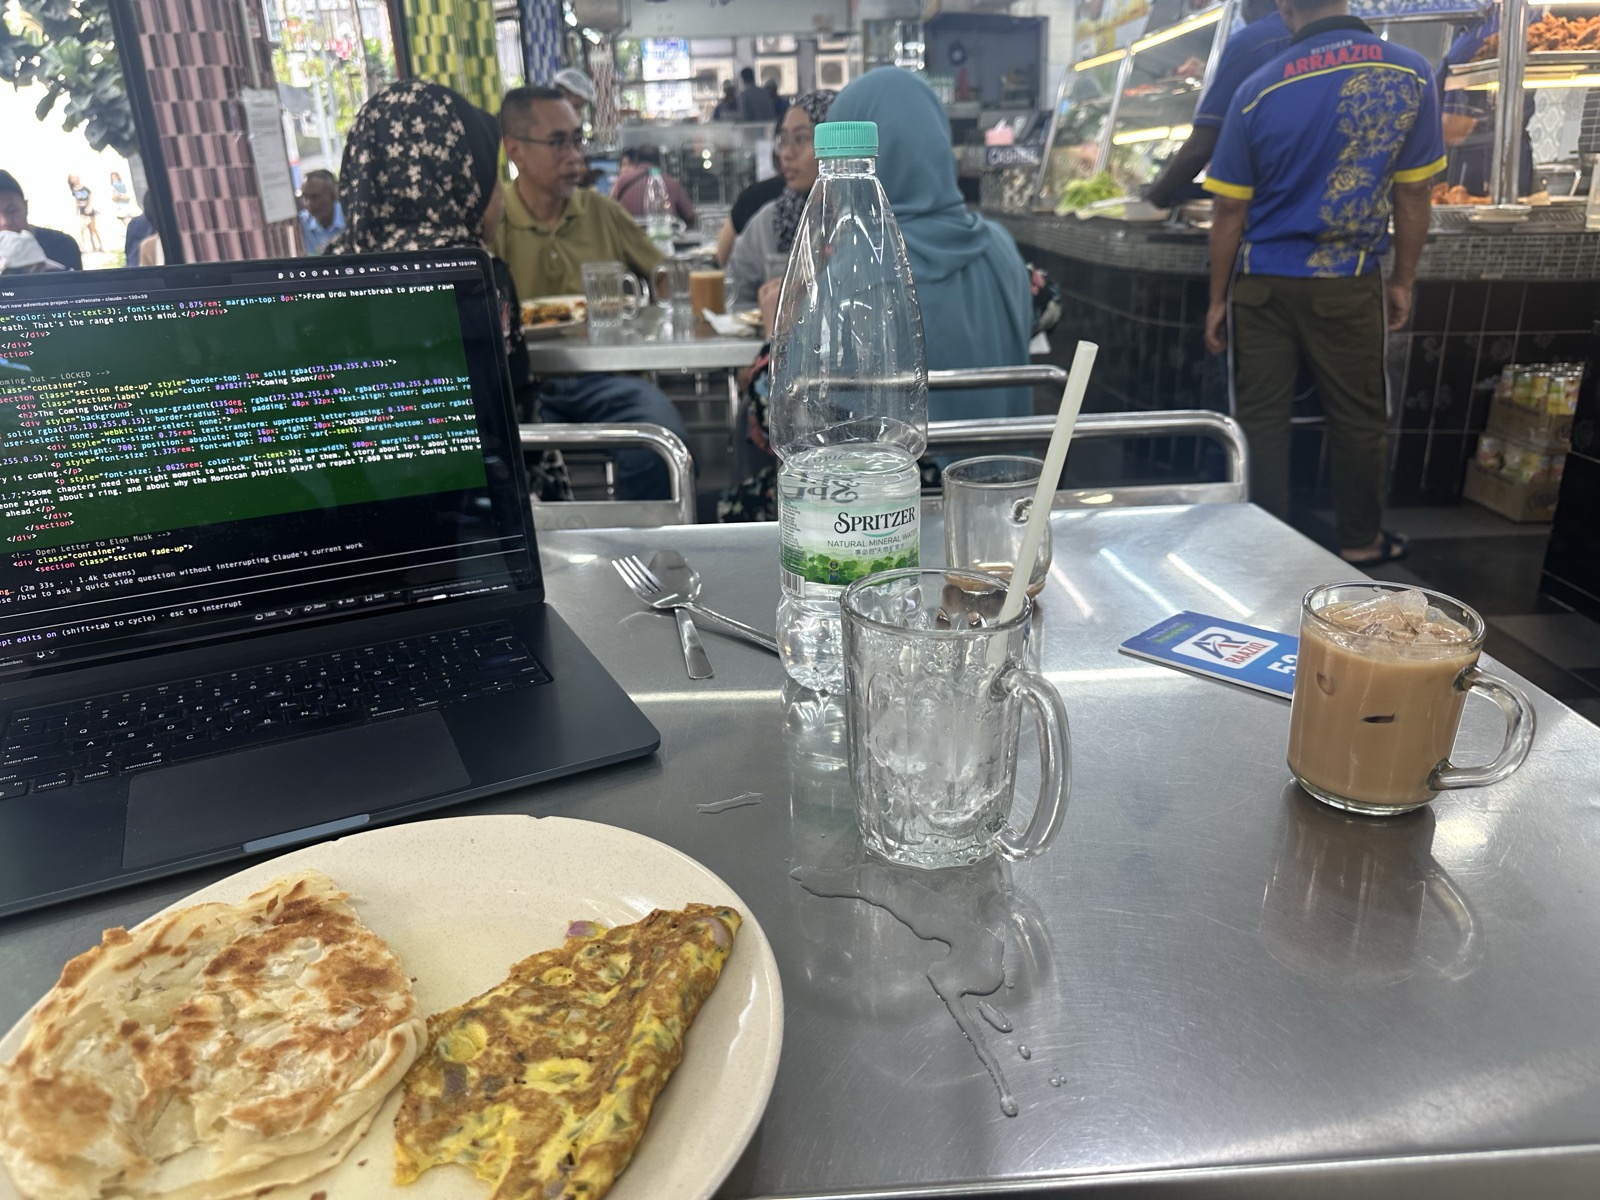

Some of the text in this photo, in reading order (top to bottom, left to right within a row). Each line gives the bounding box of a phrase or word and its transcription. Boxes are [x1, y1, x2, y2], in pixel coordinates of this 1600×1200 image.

[1283, 44, 1383, 78] ARRAAZIQ
[350, 288, 394, 297] heartbreak
[32, 320, 65, 328] That's
[60, 370, 92, 379] LOCKED
[264, 370, 287, 378] solid
[58, 406, 90, 414] Coming
[7, 428, 34, 437] solid
[57, 483, 98, 493] chapters
[101, 479, 122, 487] need
[144, 473, 169, 482] right
[172, 469, 202, 478] moment
[379, 445, 400, 454] about
[427, 440, 448, 448] about
[451, 437, 480, 445] finding
[59, 492, 85, 501] about
[146, 481, 171, 490] about
[211, 473, 248, 482] Moroccan
[252, 467, 288, 478] playlist
[291, 465, 314, 473] plays
[330, 458, 356, 468] repeat
[834, 506, 916, 534] SPRITZER
[36, 547, 57, 555] Open
[61, 542, 92, 551] Letter
[133, 533, 154, 541] Musk
[827, 540, 867, 548] NATURAL
[868, 533, 900, 547] MINERAL
[56, 585, 72, 594] ask
[85, 580, 111, 590] quick
[114, 577, 134, 585] side
[138, 571, 176, 583] question
[180, 564, 213, 575] without
[216, 557, 270, 570] interrupting
[273, 551, 309, 561] Claude's
[312, 545, 342, 555] current
[346, 542, 363, 550] work
[16, 632, 43, 642] edits
[202, 599, 243, 612] interrupt
